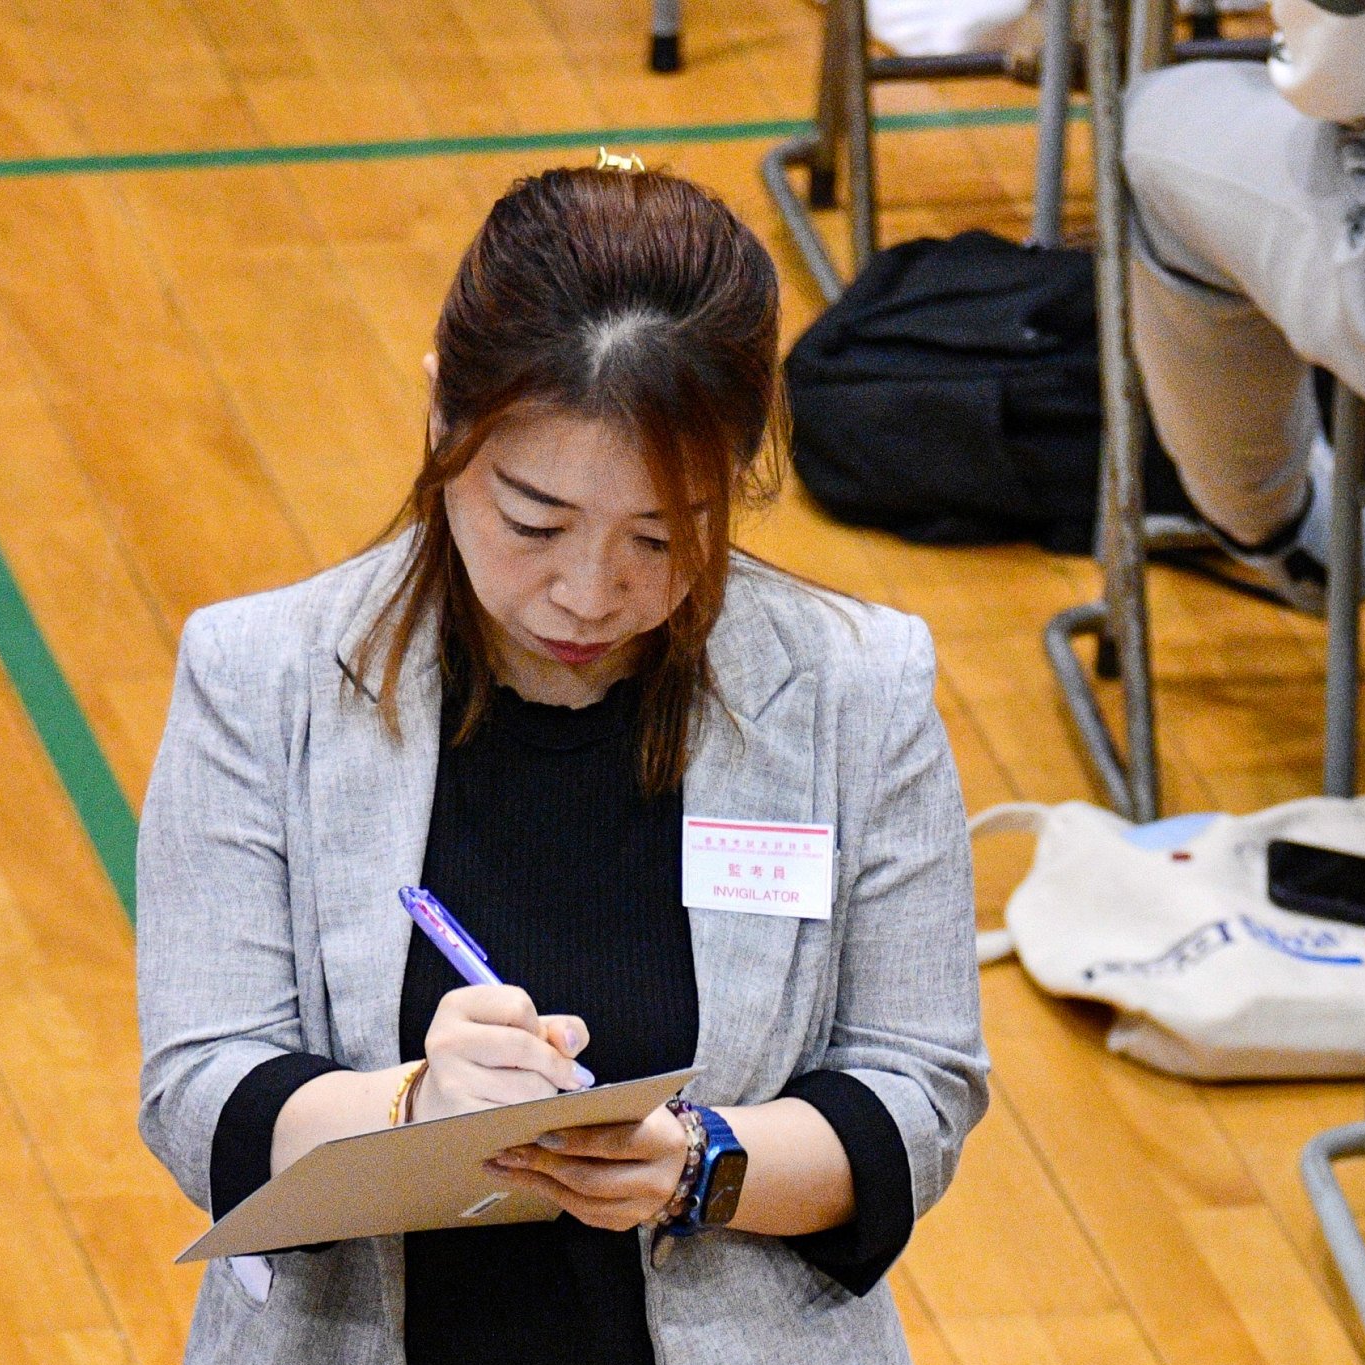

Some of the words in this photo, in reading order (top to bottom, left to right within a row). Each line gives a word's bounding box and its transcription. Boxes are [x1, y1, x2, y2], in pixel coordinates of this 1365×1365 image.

[728, 863, 786, 880] 監考員
[713, 885, 800, 903] INVIGILATOR
